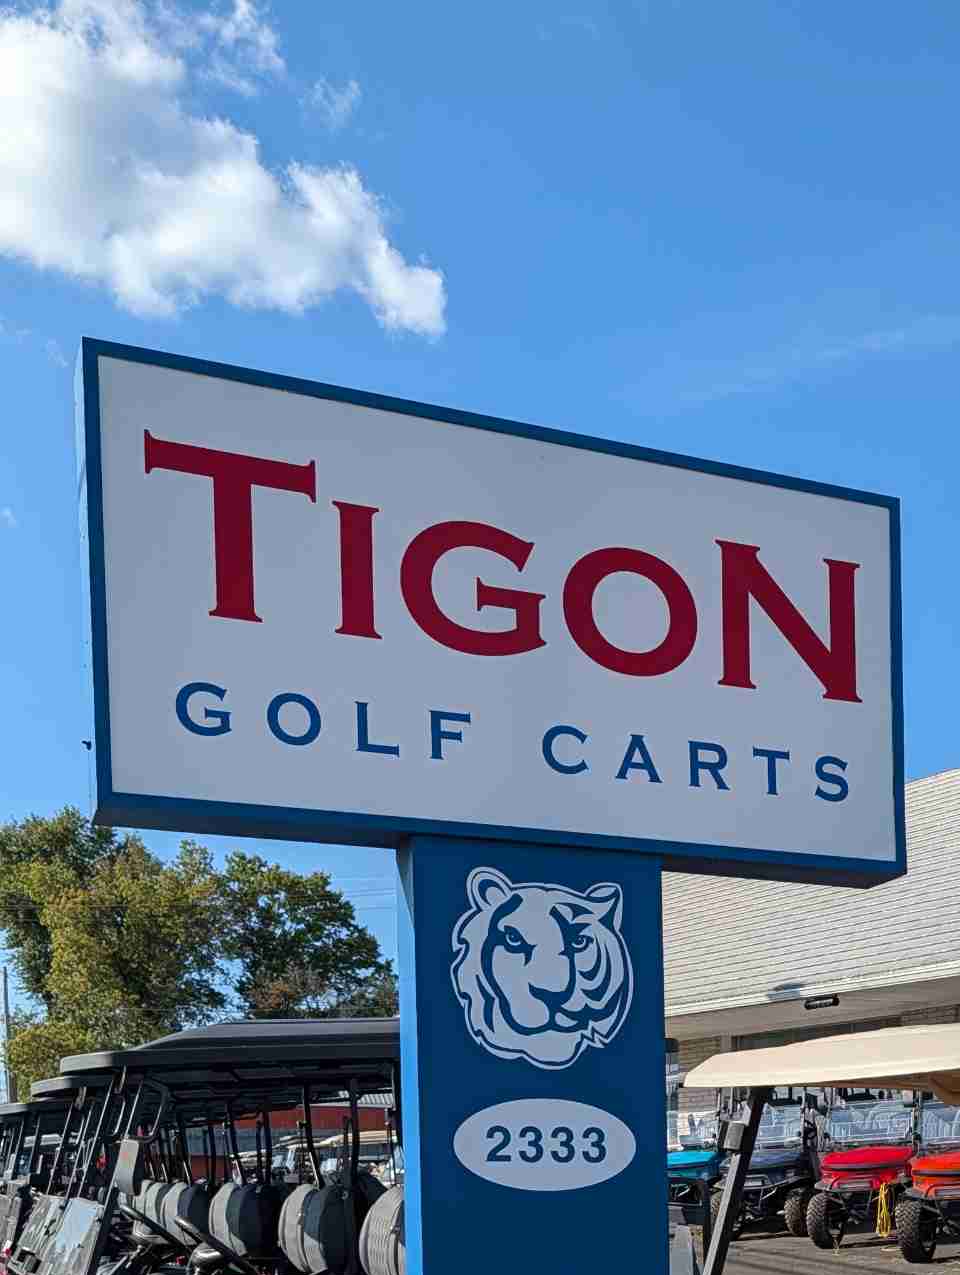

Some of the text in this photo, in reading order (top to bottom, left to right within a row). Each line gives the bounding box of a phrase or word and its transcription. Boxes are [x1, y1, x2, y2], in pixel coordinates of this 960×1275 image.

[144, 429, 862, 702] TIGON
[175, 682, 849, 802] GOLF CARTS
[486, 1126, 607, 1163] 2333
